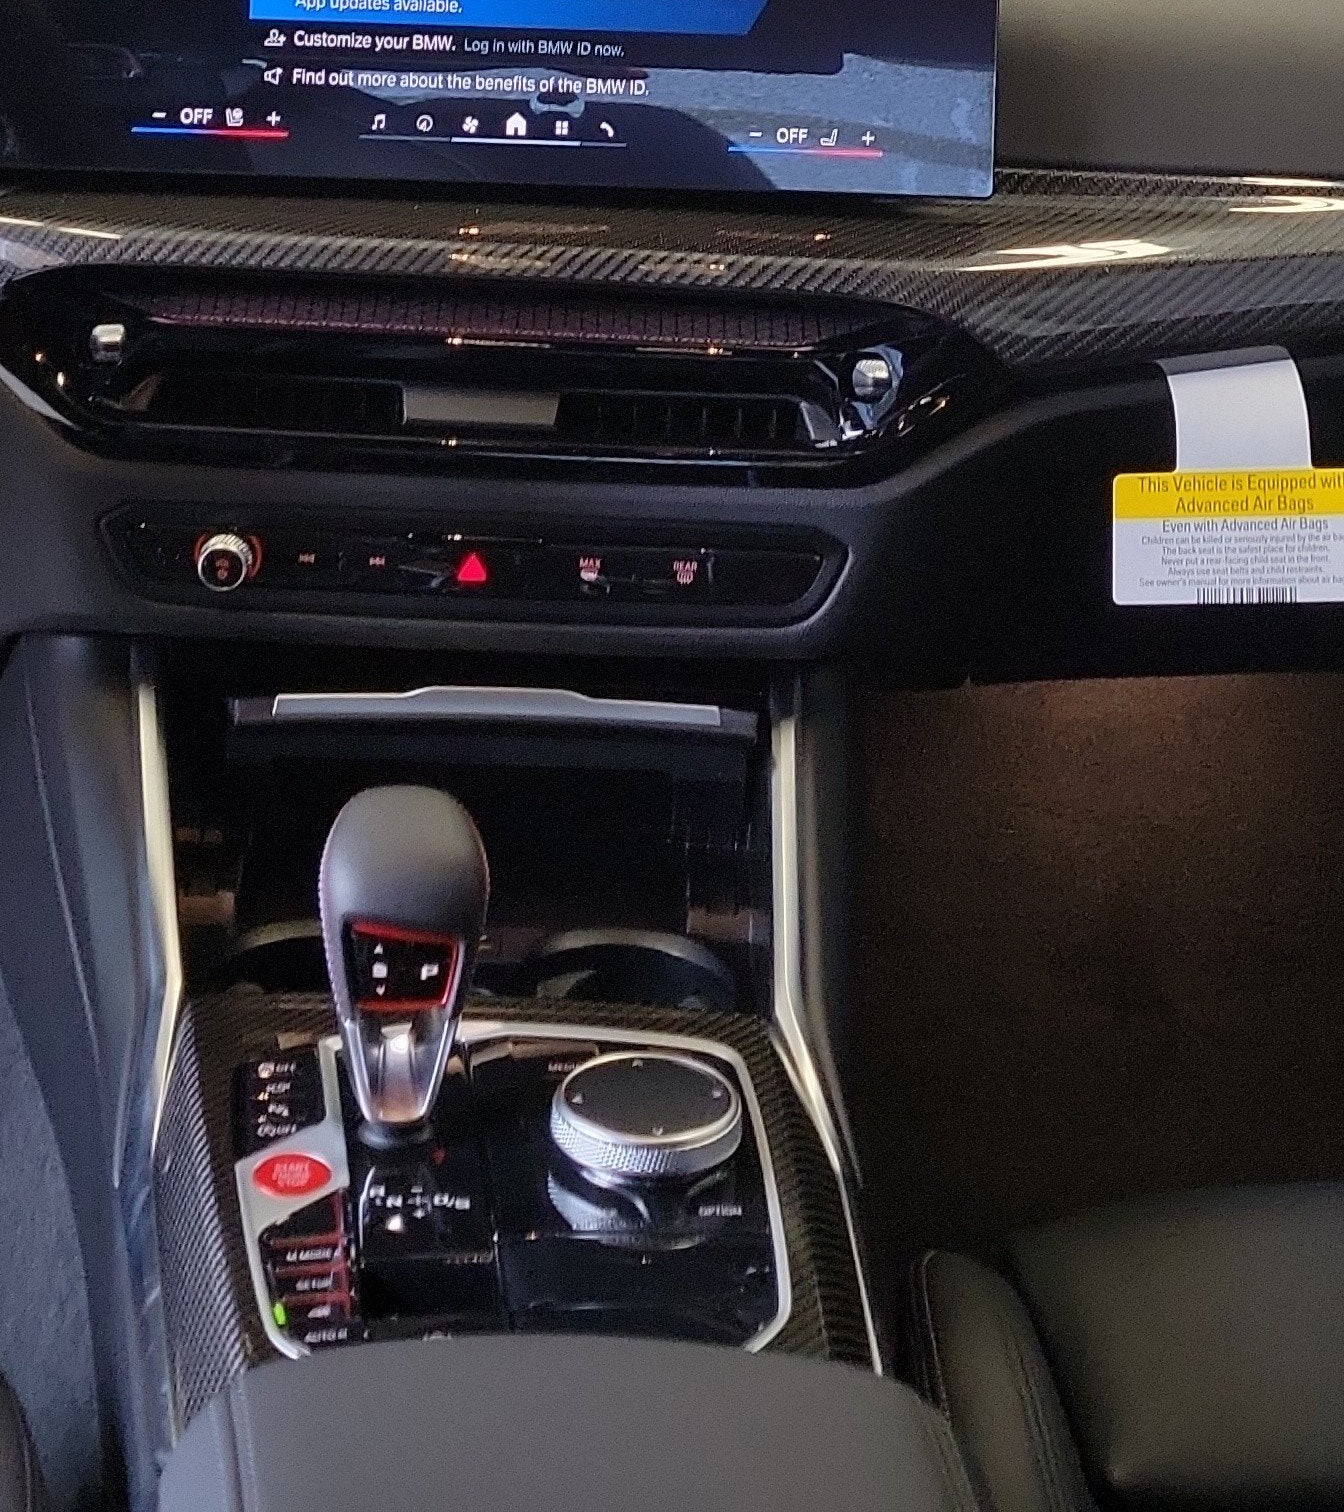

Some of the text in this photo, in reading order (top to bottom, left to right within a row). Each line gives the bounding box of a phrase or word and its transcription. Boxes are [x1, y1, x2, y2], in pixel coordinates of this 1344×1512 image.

[293, 29, 625, 57] Customize your BMW. Log in with BMW ID now.
[292, 67, 650, 96] Find out more about the benefits of the BMW ID.
[180, 107, 214, 125] OFF
[776, 127, 809, 144] OFF
[1138, 475, 1169, 494] This
[1173, 474, 1227, 493] Vehicle
[1231, 474, 1243, 491] is
[1247, 473, 1317, 495] Equipped
[1175, 494, 1315, 514] Advanced Air Bags
[1162, 516, 1329, 534] Even with Advanced Air Bags
[1141, 535, 1174, 545] Children
[1176, 536, 1190, 544] can
[1202, 535, 1223, 543] killed
[1308, 533, 1321, 542] the
[1163, 546, 1176, 555] The
[1178, 546, 1196, 555] back
[1198, 546, 1215, 555] seat
[1224, 545, 1237, 554] the
[1238, 544, 1261, 554] safest
[1263, 544, 1285, 555] place
[579, 557, 601, 569] MAX
[1161, 556, 1184, 566] Never
[1185, 556, 1198, 566] put
[1250, 555, 1268, 565] child
[1296, 554, 1309, 563] the
[1168, 567, 1194, 576] Always
[1196, 568, 1210, 576] use
[1212, 567, 1229, 576] seat
[1230, 566, 1249, 575] belts
[1251, 566, 1265, 575] and
[1266, 565, 1285, 575] child
[1139, 577, 1154, 587] See
[1188, 577, 1217, 586] manual
[1218, 576, 1229, 586] for
[1230, 577, 1250, 586] more
[1251, 575, 1296, 585] information
[1298, 575, 1319, 584] about
[420, 963, 439, 981] P
